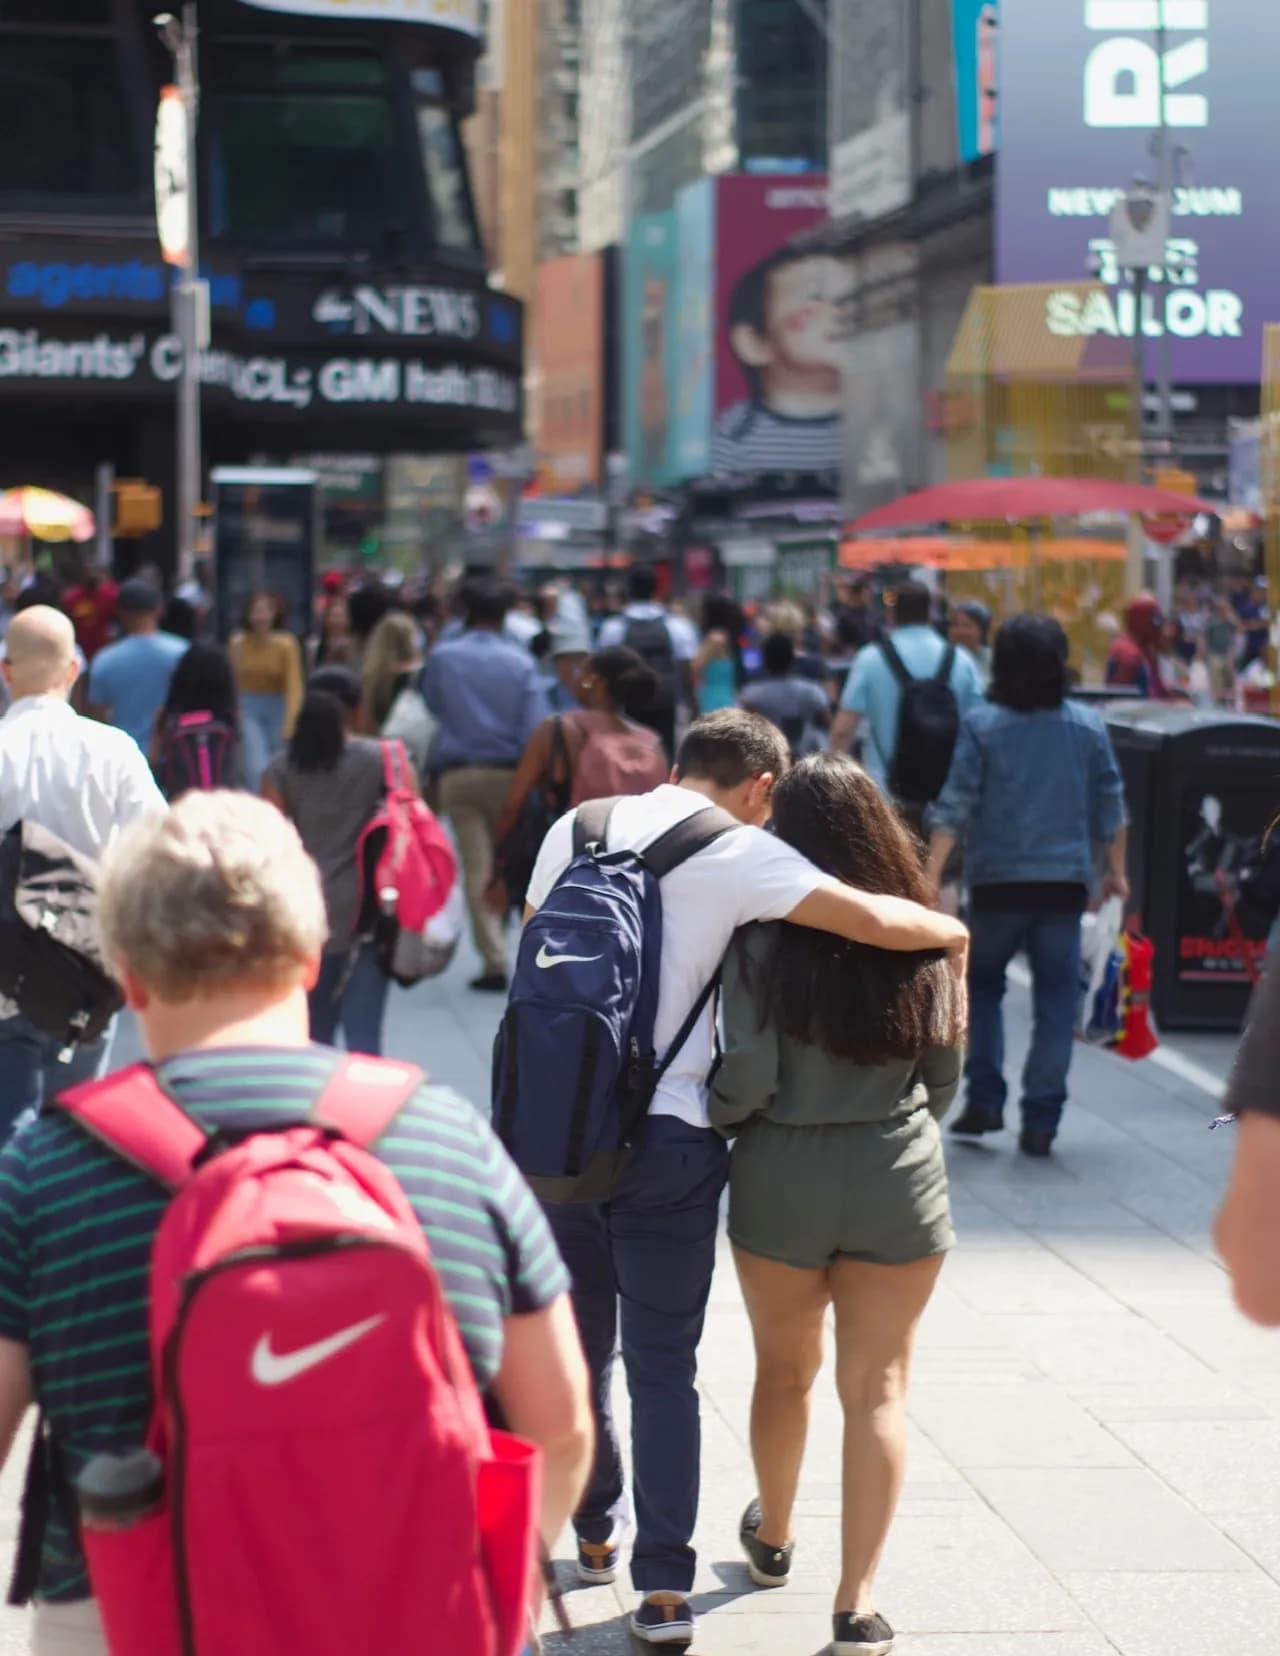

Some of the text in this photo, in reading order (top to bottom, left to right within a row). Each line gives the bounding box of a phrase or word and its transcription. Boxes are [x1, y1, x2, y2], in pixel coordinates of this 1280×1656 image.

[353, 284, 479, 339] NEWS
[1045, 289, 1243, 337] SAILOR
[319, 357, 399, 402] GM
